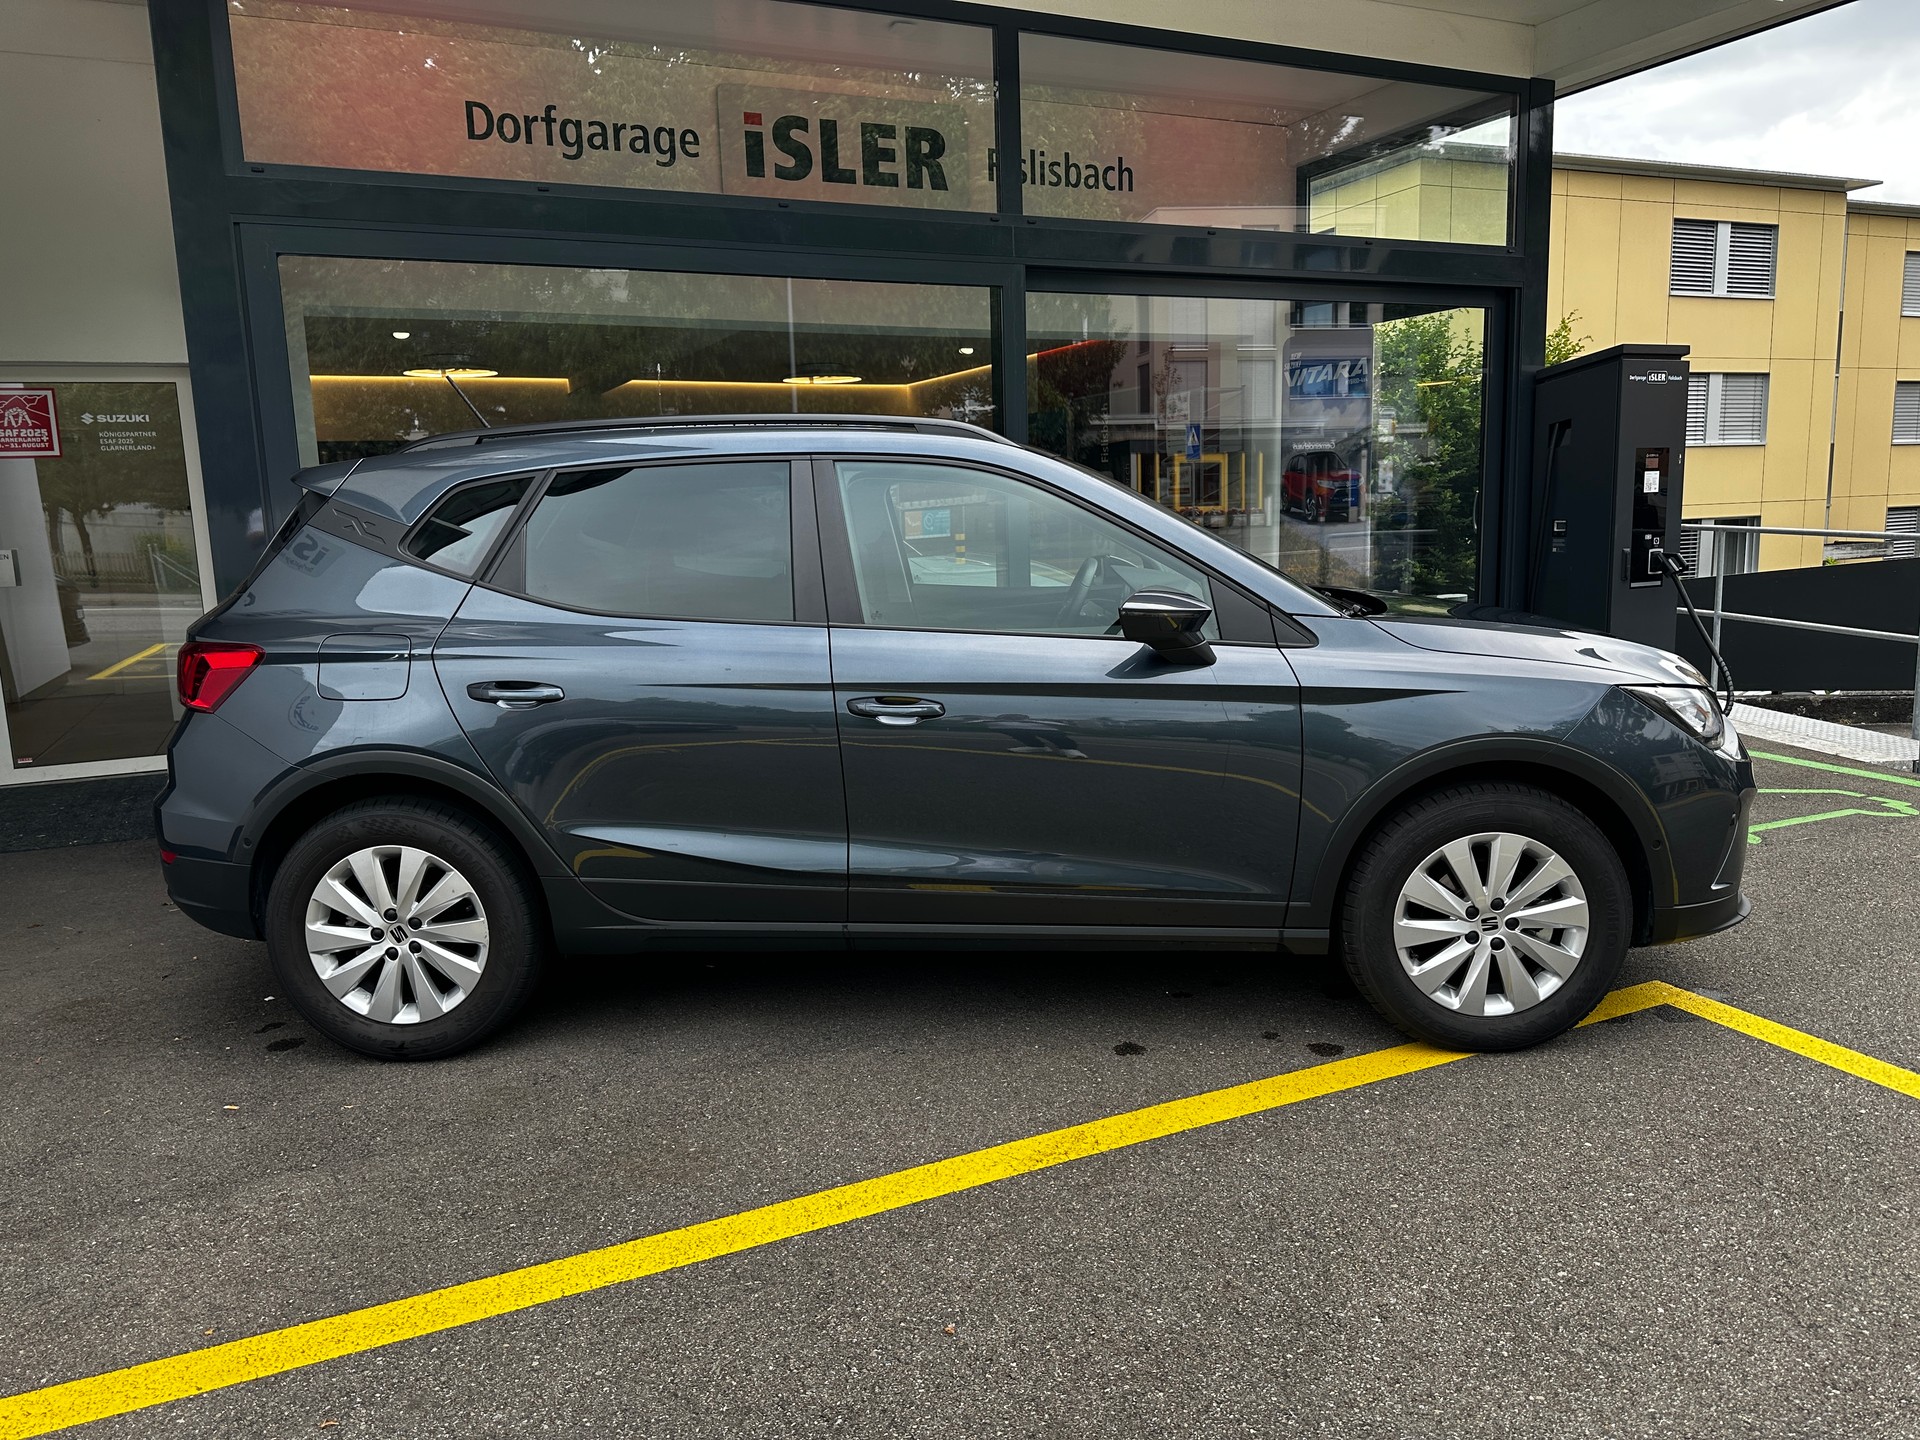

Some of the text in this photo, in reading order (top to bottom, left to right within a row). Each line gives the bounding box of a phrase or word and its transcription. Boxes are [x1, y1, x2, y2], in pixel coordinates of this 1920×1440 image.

[465, 100, 1133, 192] Dorfgarage iSLER Fslisbach
[1284, 357, 1368, 387] VITARA
[97, 414, 150, 423] SUZUKI
